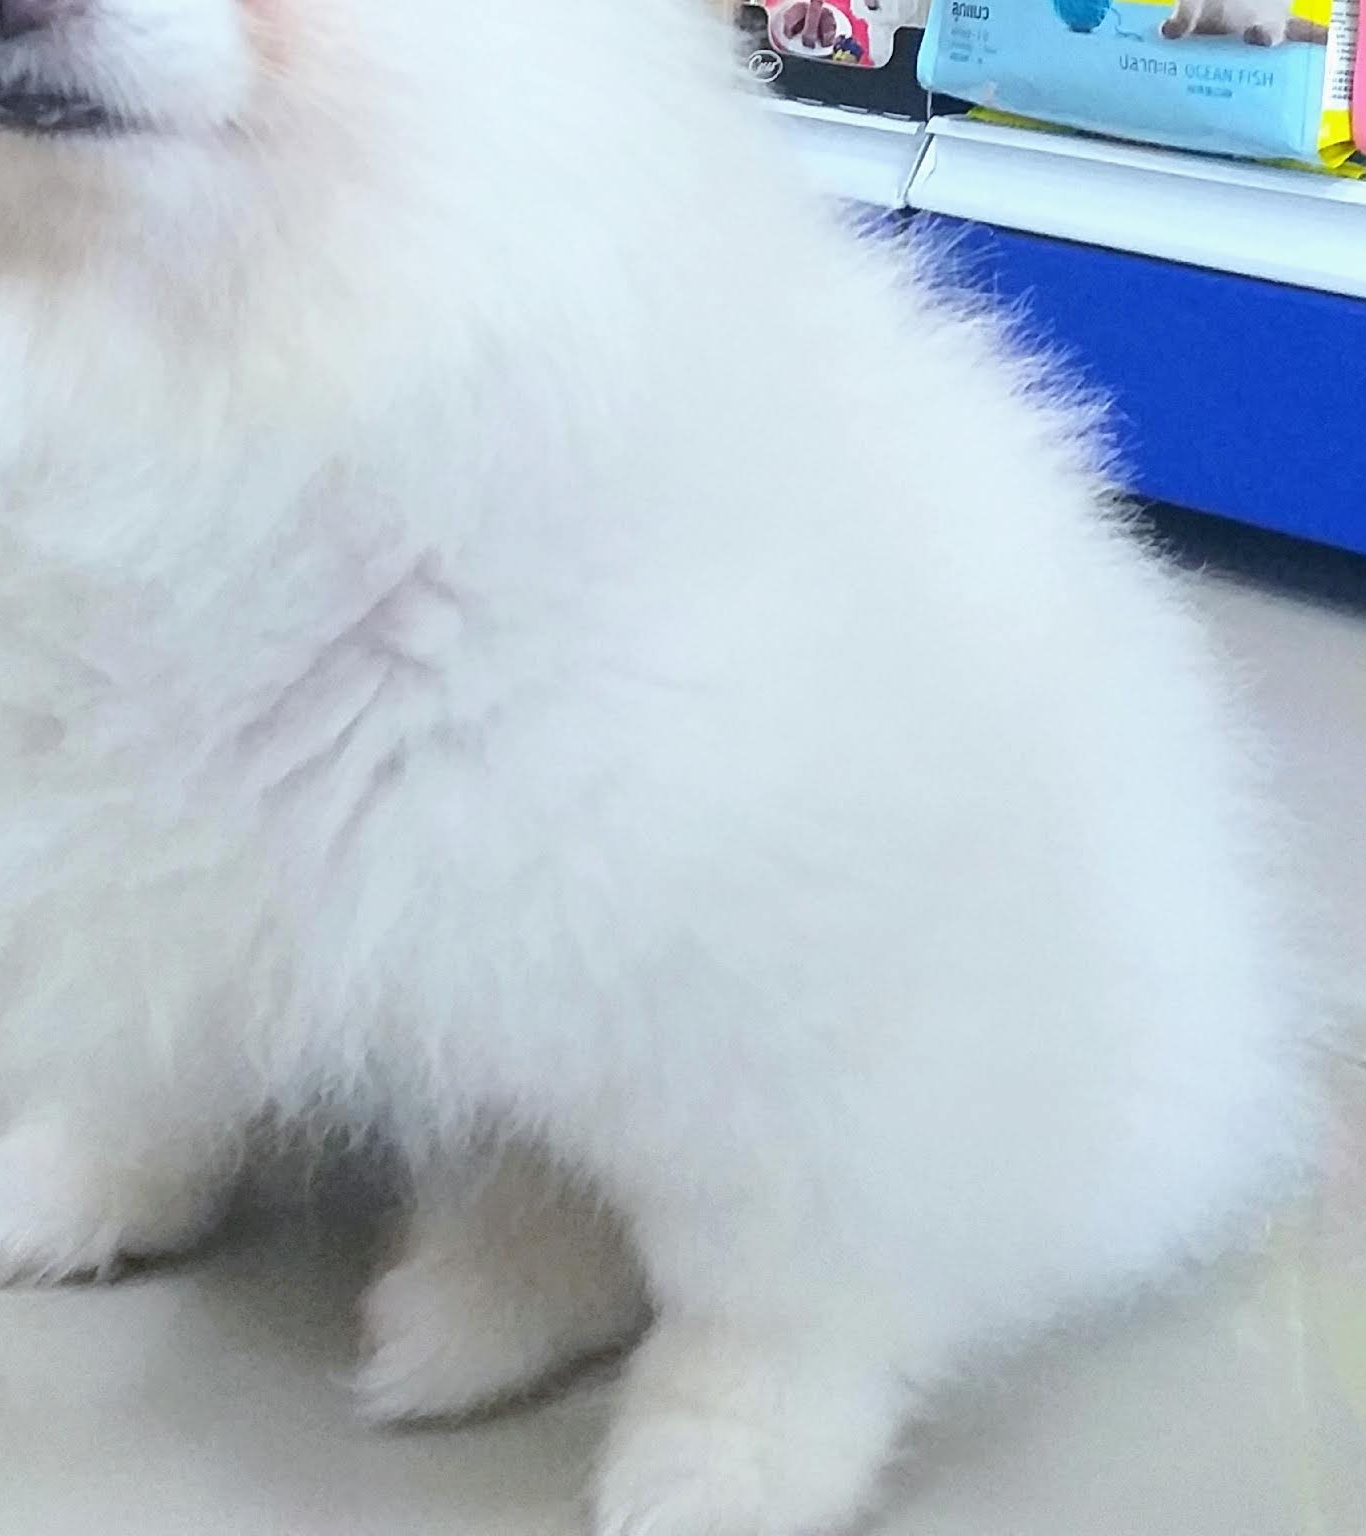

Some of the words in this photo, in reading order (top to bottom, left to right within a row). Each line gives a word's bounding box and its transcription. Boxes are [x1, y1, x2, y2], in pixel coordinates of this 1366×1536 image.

[951, 1, 990, 23] ลูกแมว
[1185, 64, 1233, 84] OCEAN
[1238, 68, 1275, 89] FISH
